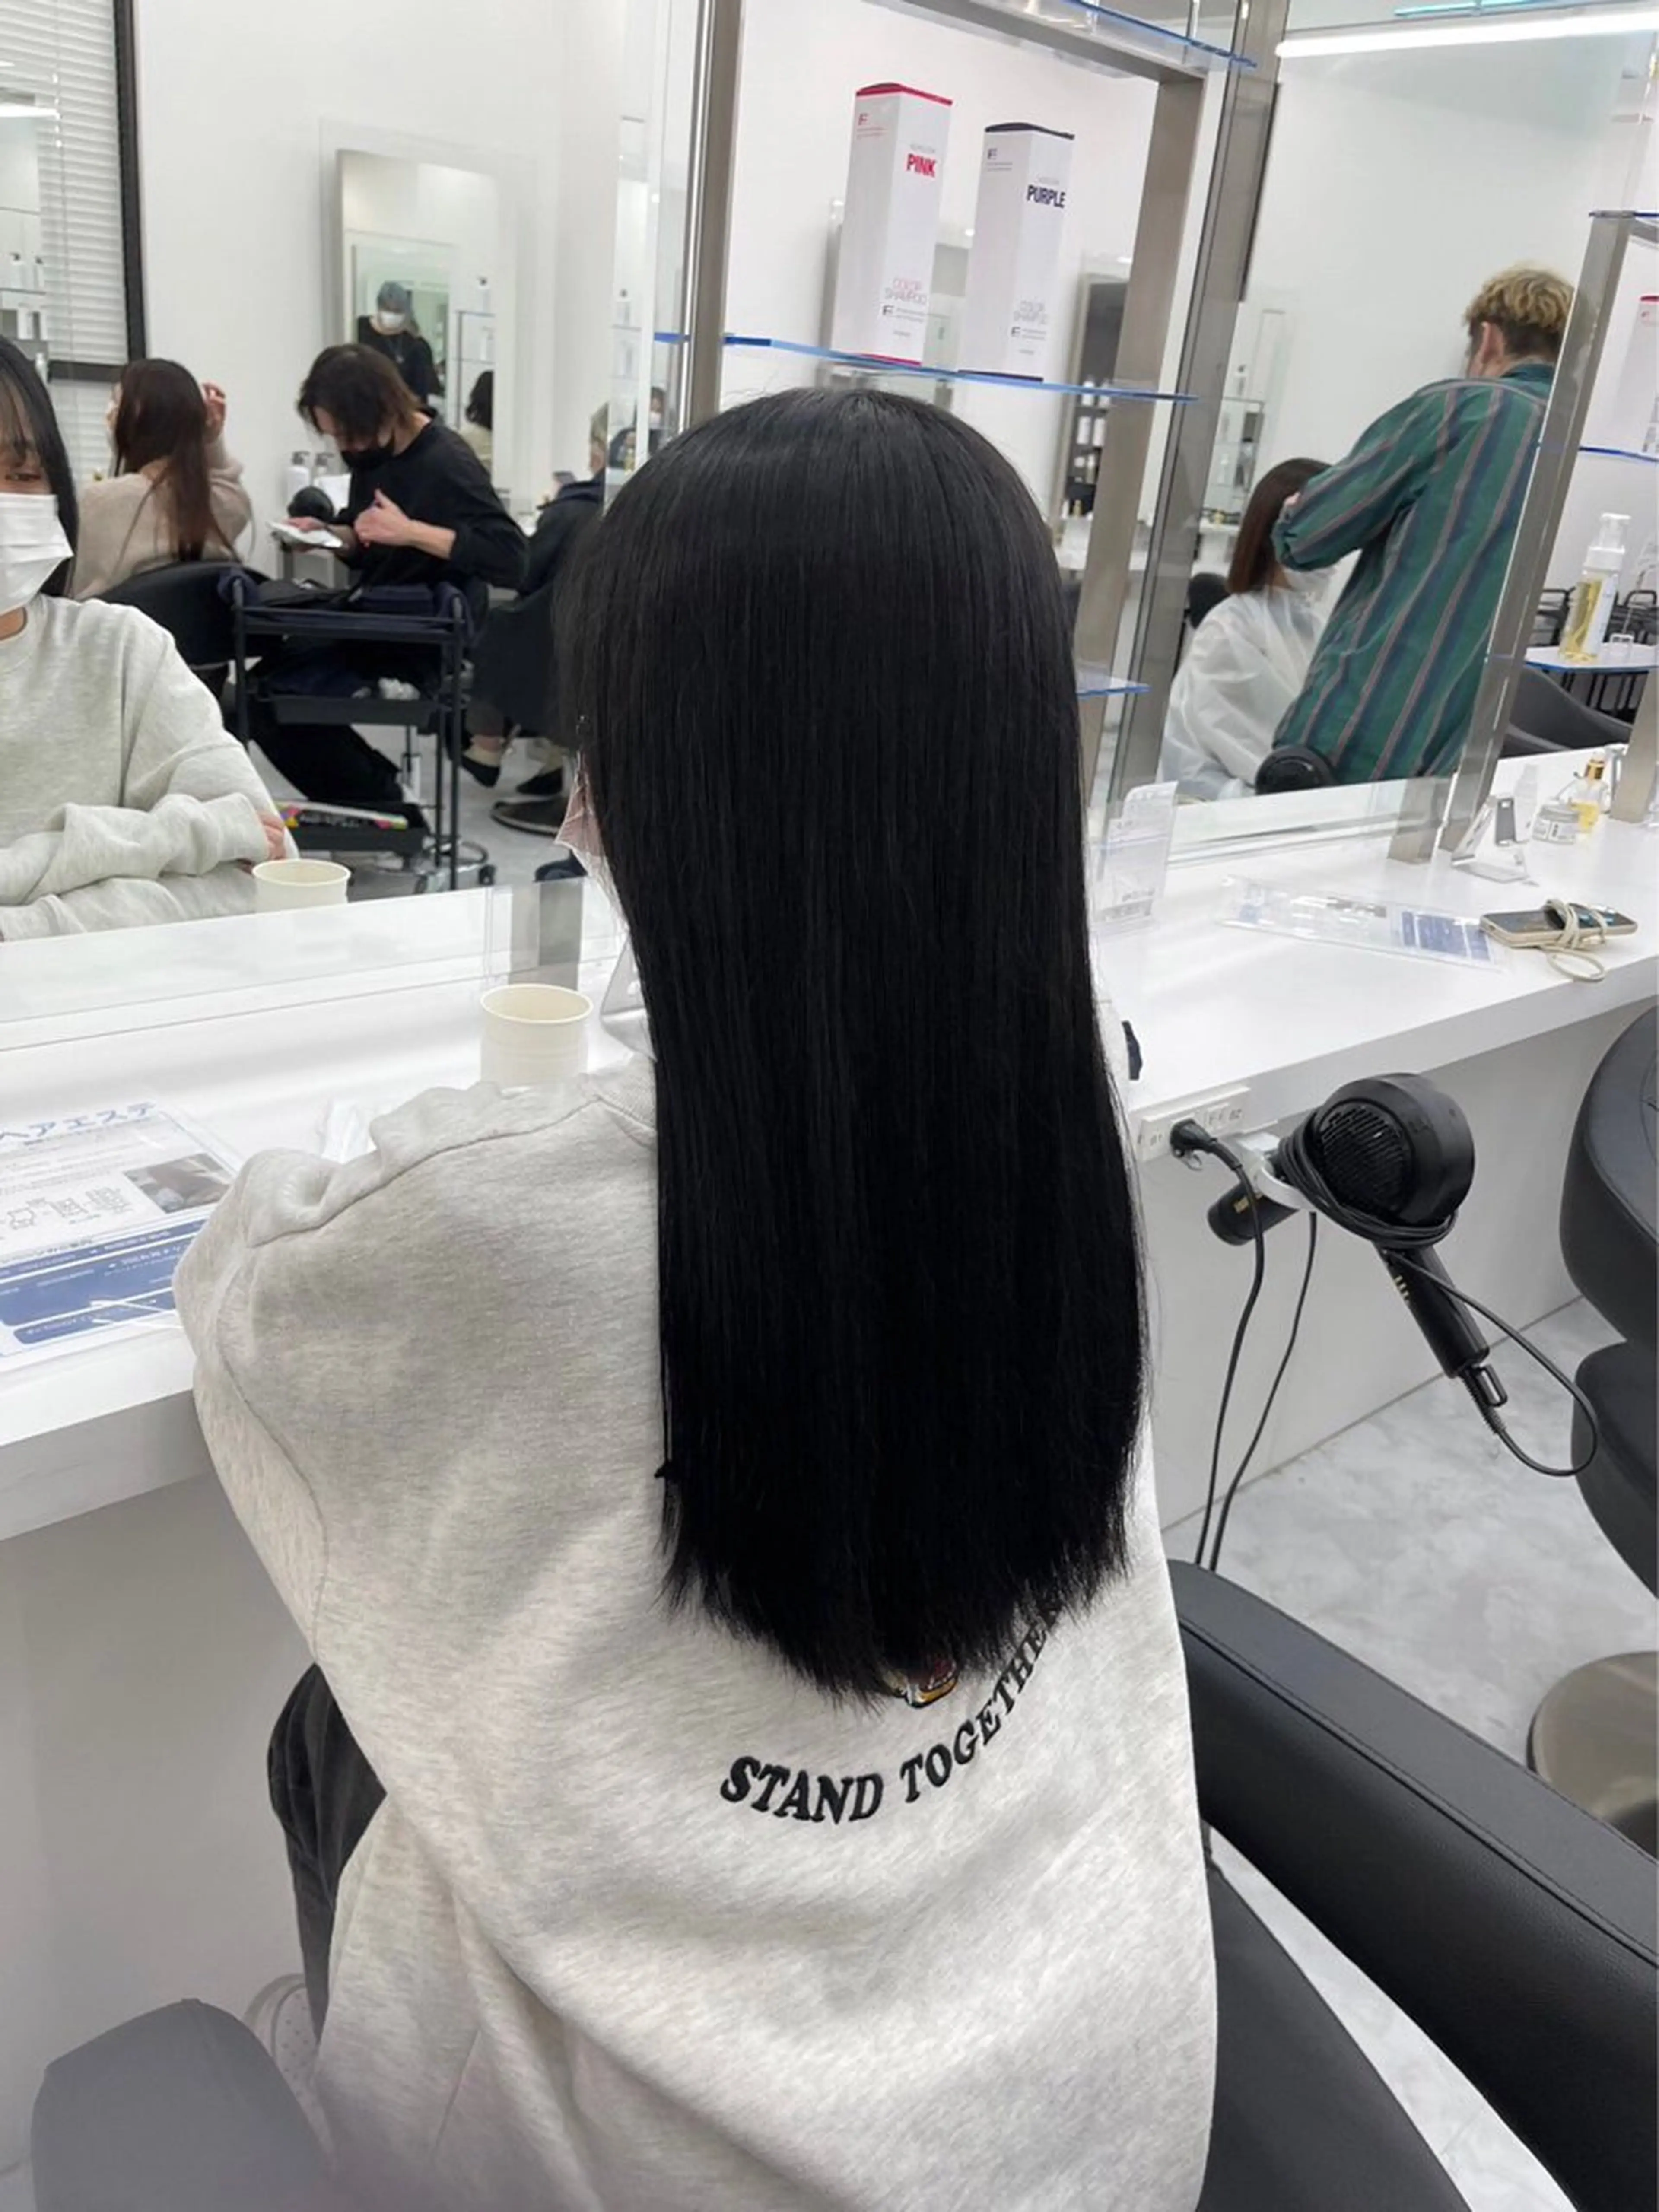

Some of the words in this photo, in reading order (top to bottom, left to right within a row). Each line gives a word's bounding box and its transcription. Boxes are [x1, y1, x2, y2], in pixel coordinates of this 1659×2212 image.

[906, 153, 937, 178] PINK
[1027, 184, 1066, 209] PURPLE
[720, 1756, 883, 1825] STAND
